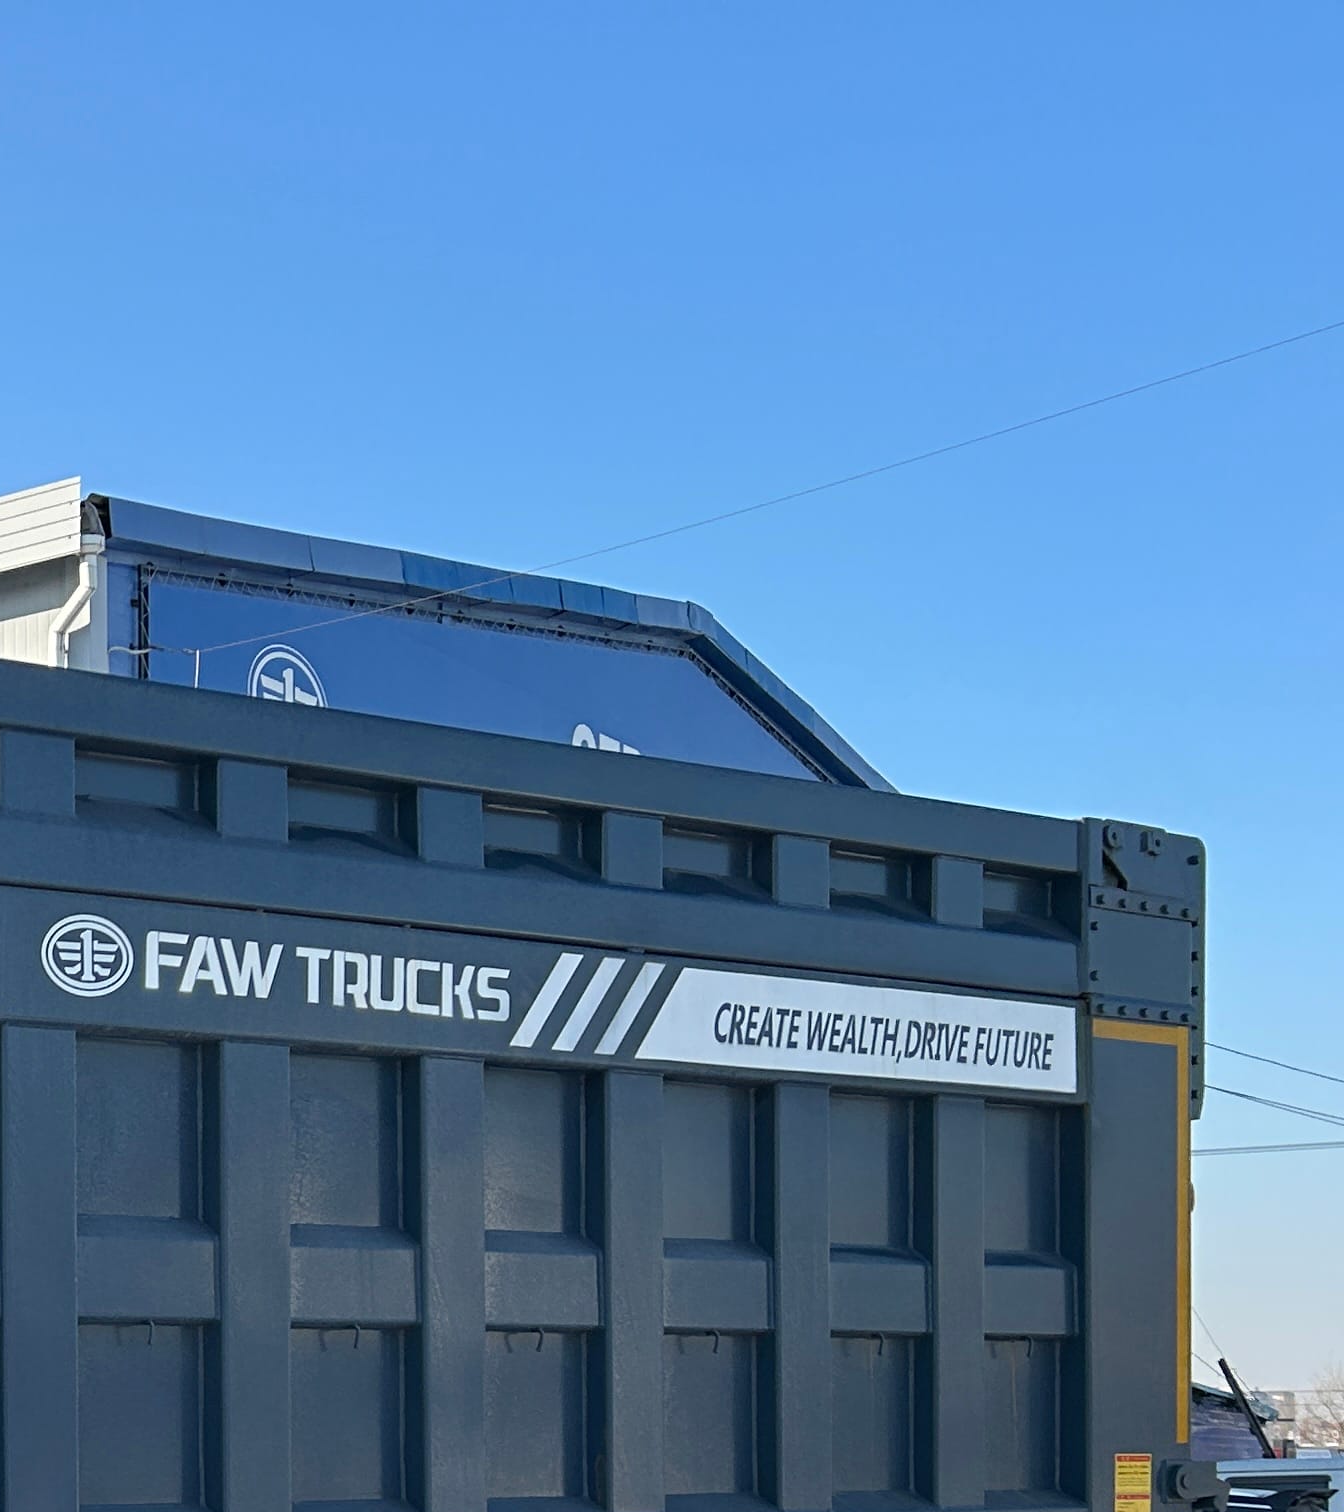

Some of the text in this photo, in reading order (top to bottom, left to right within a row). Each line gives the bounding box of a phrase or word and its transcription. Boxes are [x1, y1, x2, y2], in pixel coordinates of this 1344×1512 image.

[144, 929, 511, 1022] FAW TRUCKS
[714, 1002, 802, 1049] CREATE
[973, 1027, 1055, 1071] FUTURE
